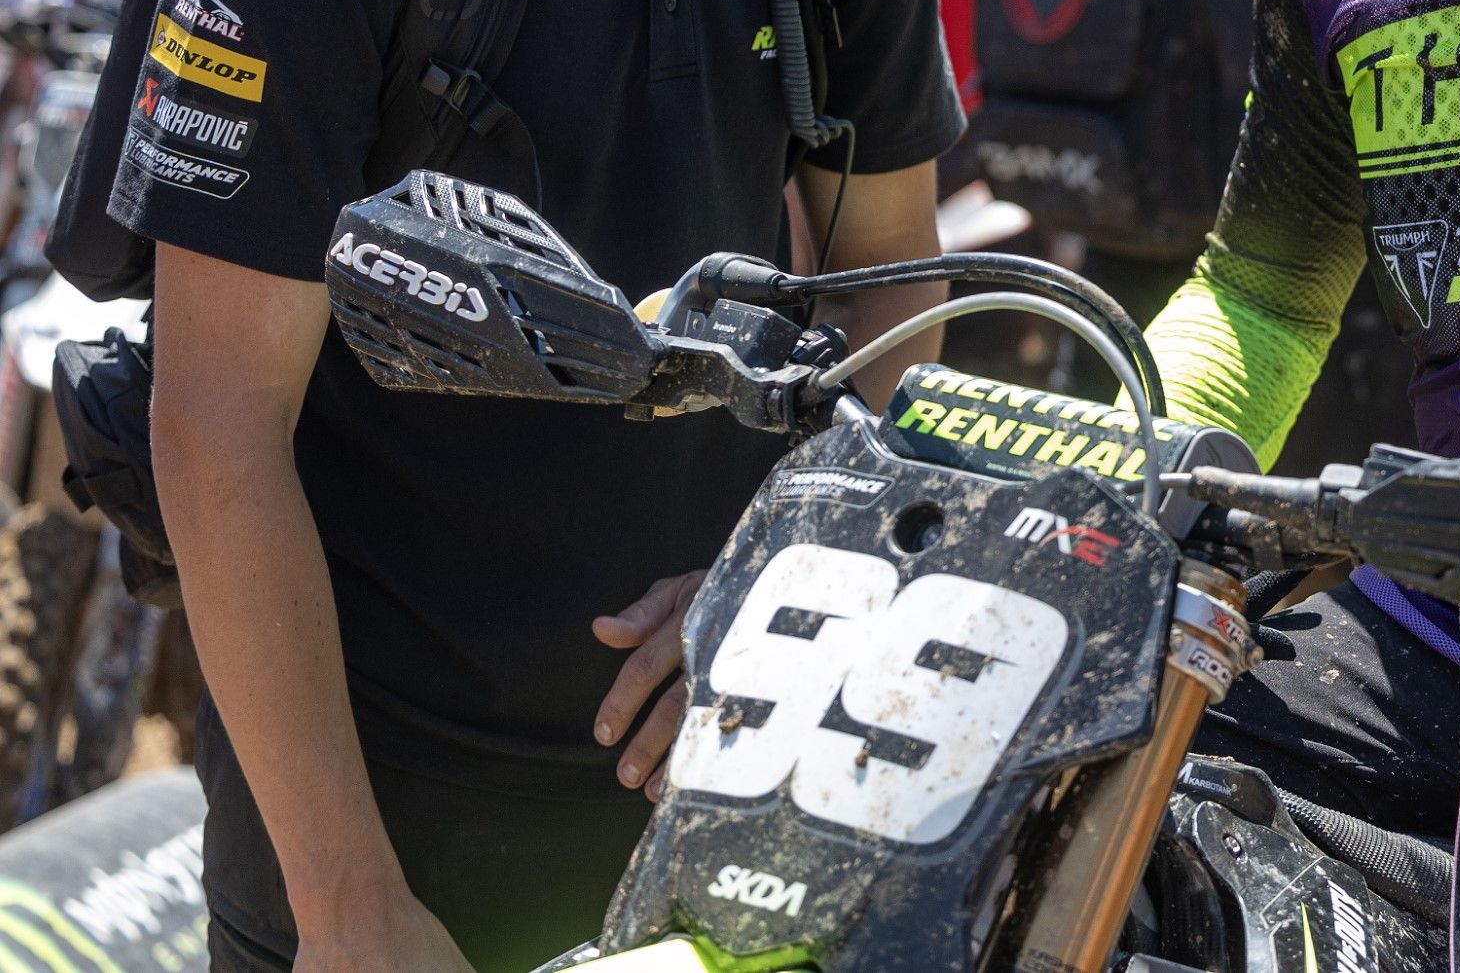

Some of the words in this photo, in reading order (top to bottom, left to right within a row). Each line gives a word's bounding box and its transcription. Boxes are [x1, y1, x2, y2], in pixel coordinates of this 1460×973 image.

[165, 37, 257, 84] DUNLOP
[130, 150, 197, 184] LUBRICANTS
[135, 139, 240, 184] PERFORMANCE
[1379, 230, 1431, 248] TRIUMPH
[895, 398, 1147, 482] RENTHAL
[670, 543, 1069, 845] 99
[1327, 879, 1367, 959] DUTY
